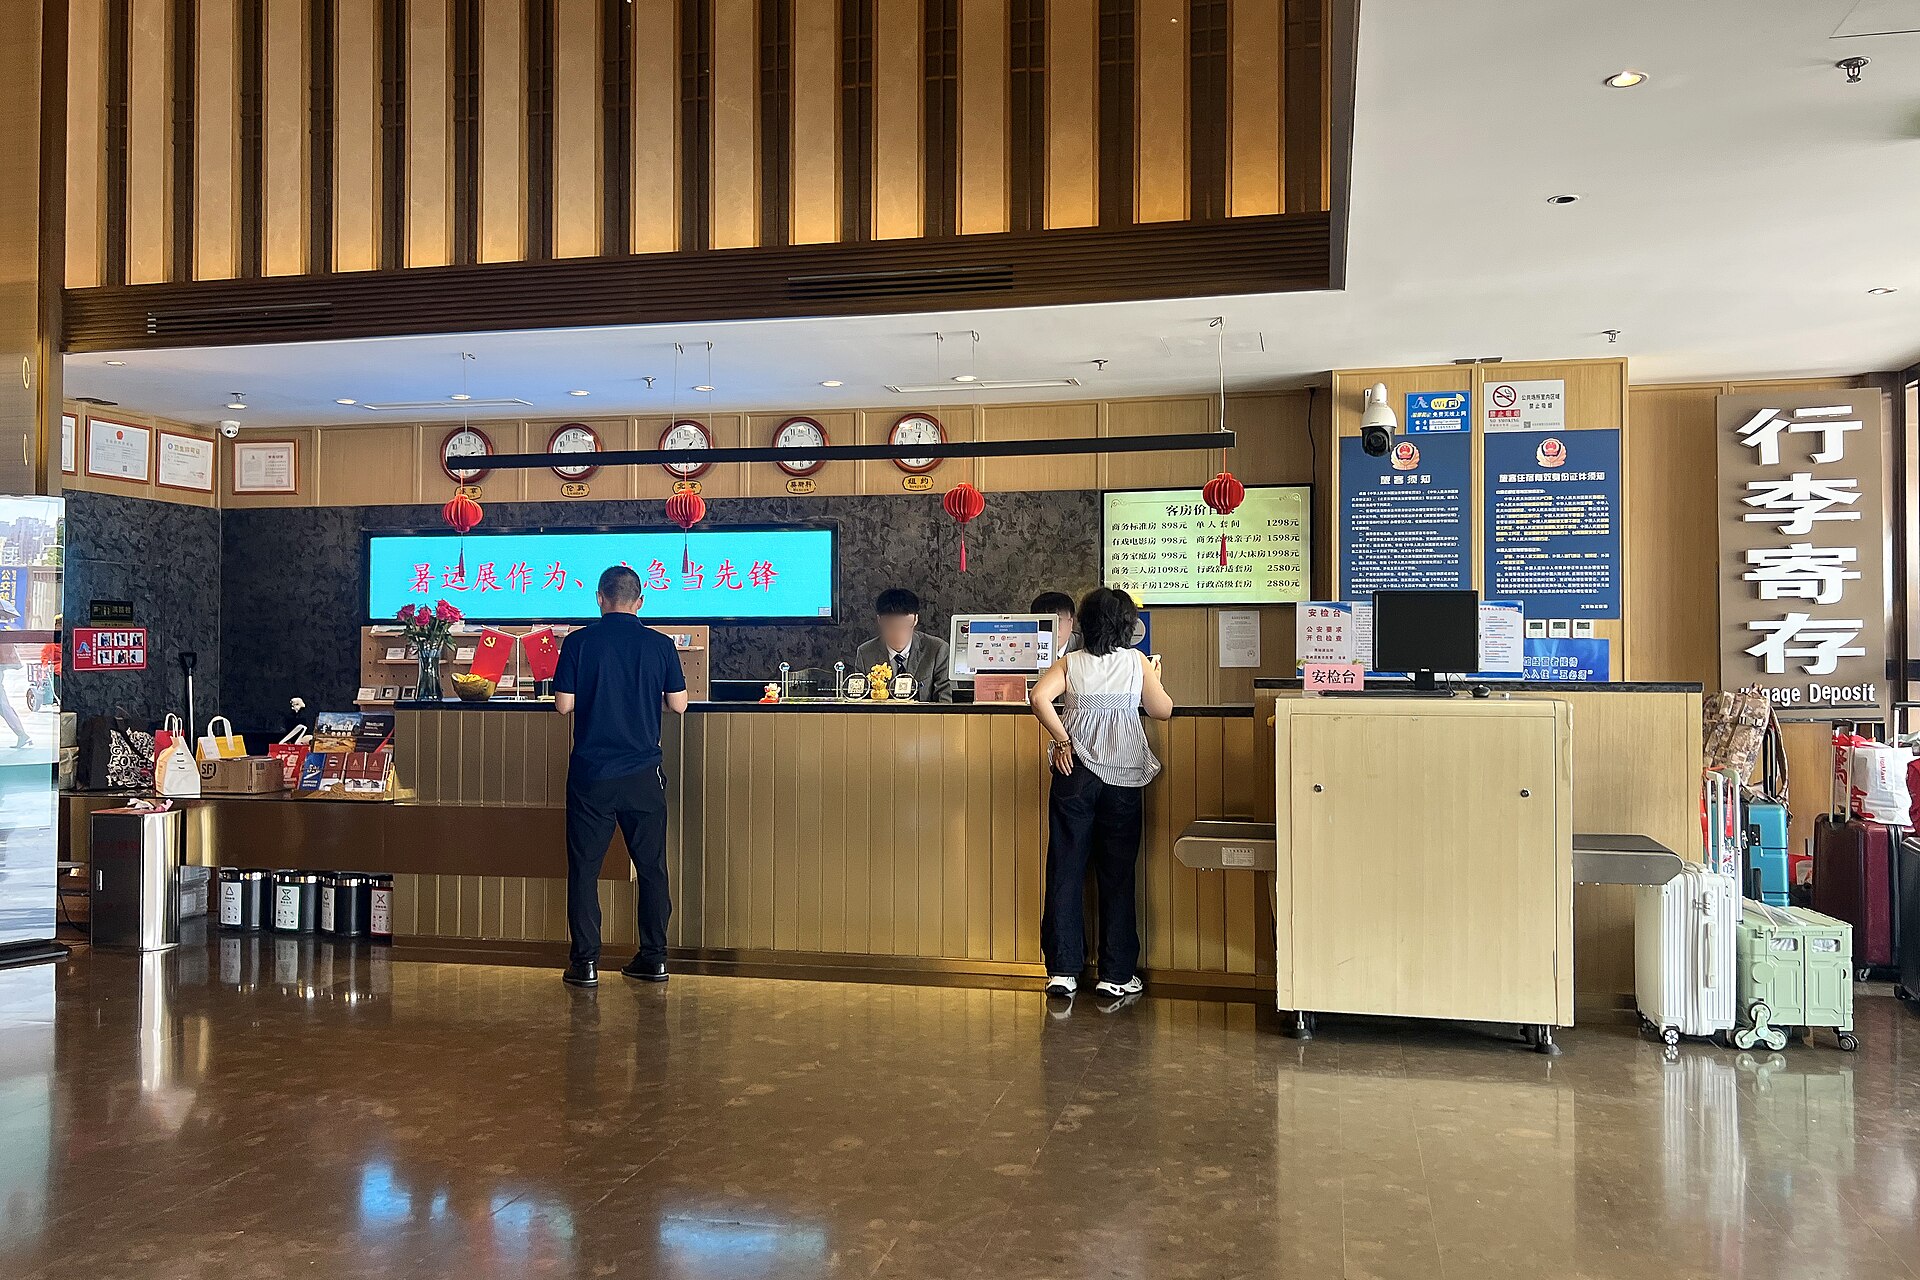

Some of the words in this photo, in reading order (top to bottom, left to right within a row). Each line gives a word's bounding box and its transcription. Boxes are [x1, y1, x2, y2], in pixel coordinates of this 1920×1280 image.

[1165, 504, 1236, 517] 客房价目
[1161, 521, 1188, 530] 898元
[1266, 518, 1300, 527] 1298元
[1161, 536, 1188, 545] 998元
[1267, 533, 1300, 542] 1598元
[1736, 405, 1866, 676] 行李寄存
[1161, 552, 1188, 560] 998元
[1267, 549, 1300, 558] 1998元
[1267, 563, 1301, 572] 2580元
[407, 559, 780, 594] 暑运展作为、急当先锋
[1266, 579, 1300, 588] 2880元
[1308, 608, 1341, 618] 安检台
[1306, 634, 1342, 642] 开包检查
[1312, 669, 1356, 684] 安检台
[1809, 683, 1876, 706] Deposit
[201, 763, 213, 775] SF
